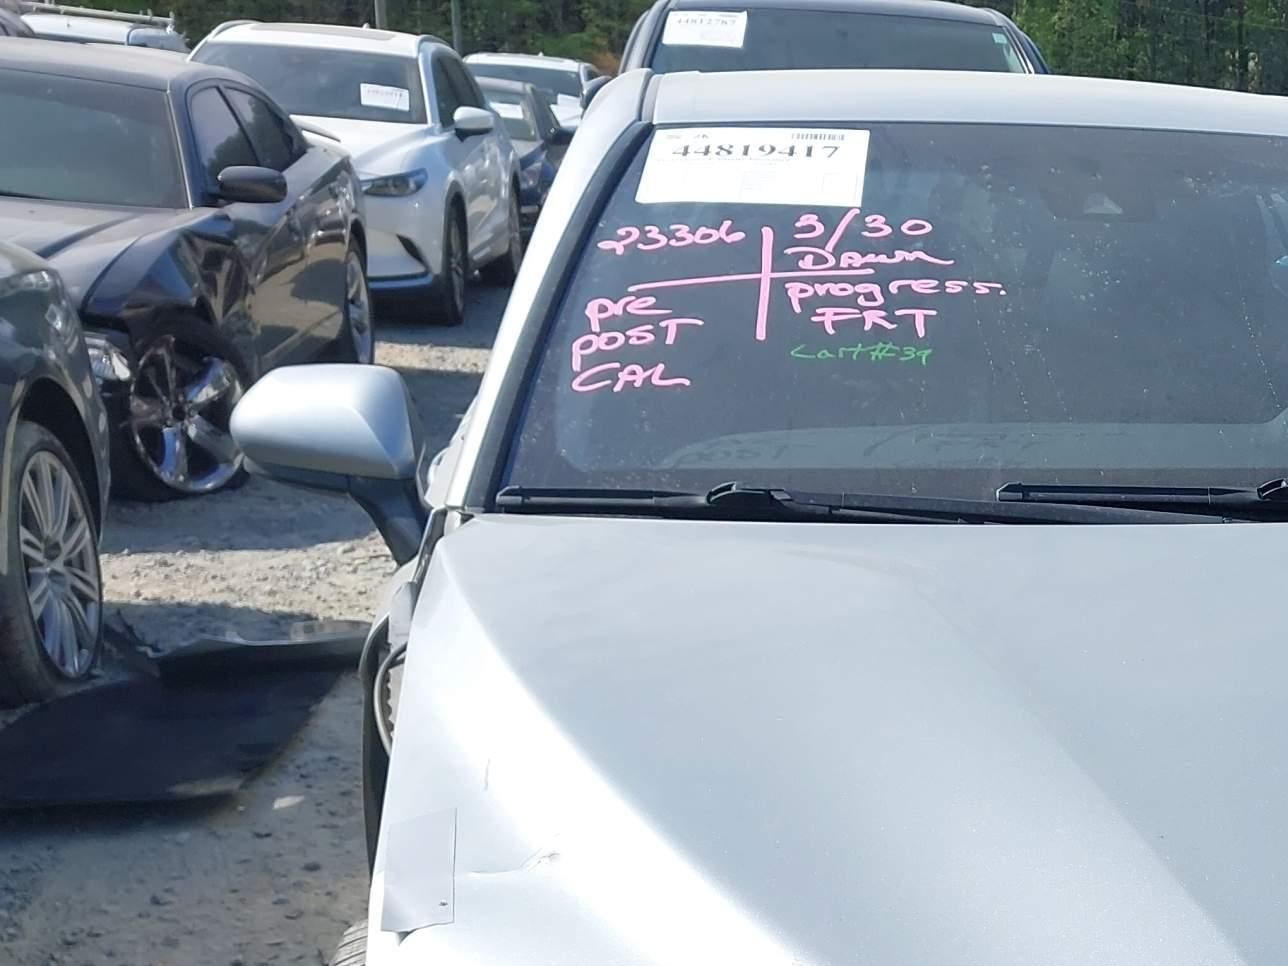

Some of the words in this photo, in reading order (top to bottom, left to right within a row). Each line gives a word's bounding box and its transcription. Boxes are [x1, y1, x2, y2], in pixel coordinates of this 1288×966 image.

[672, 143, 841, 159] 44819417
[597, 219, 746, 255] 23306
[811, 306, 938, 338] FRT
[571, 362, 691, 392] CAL
